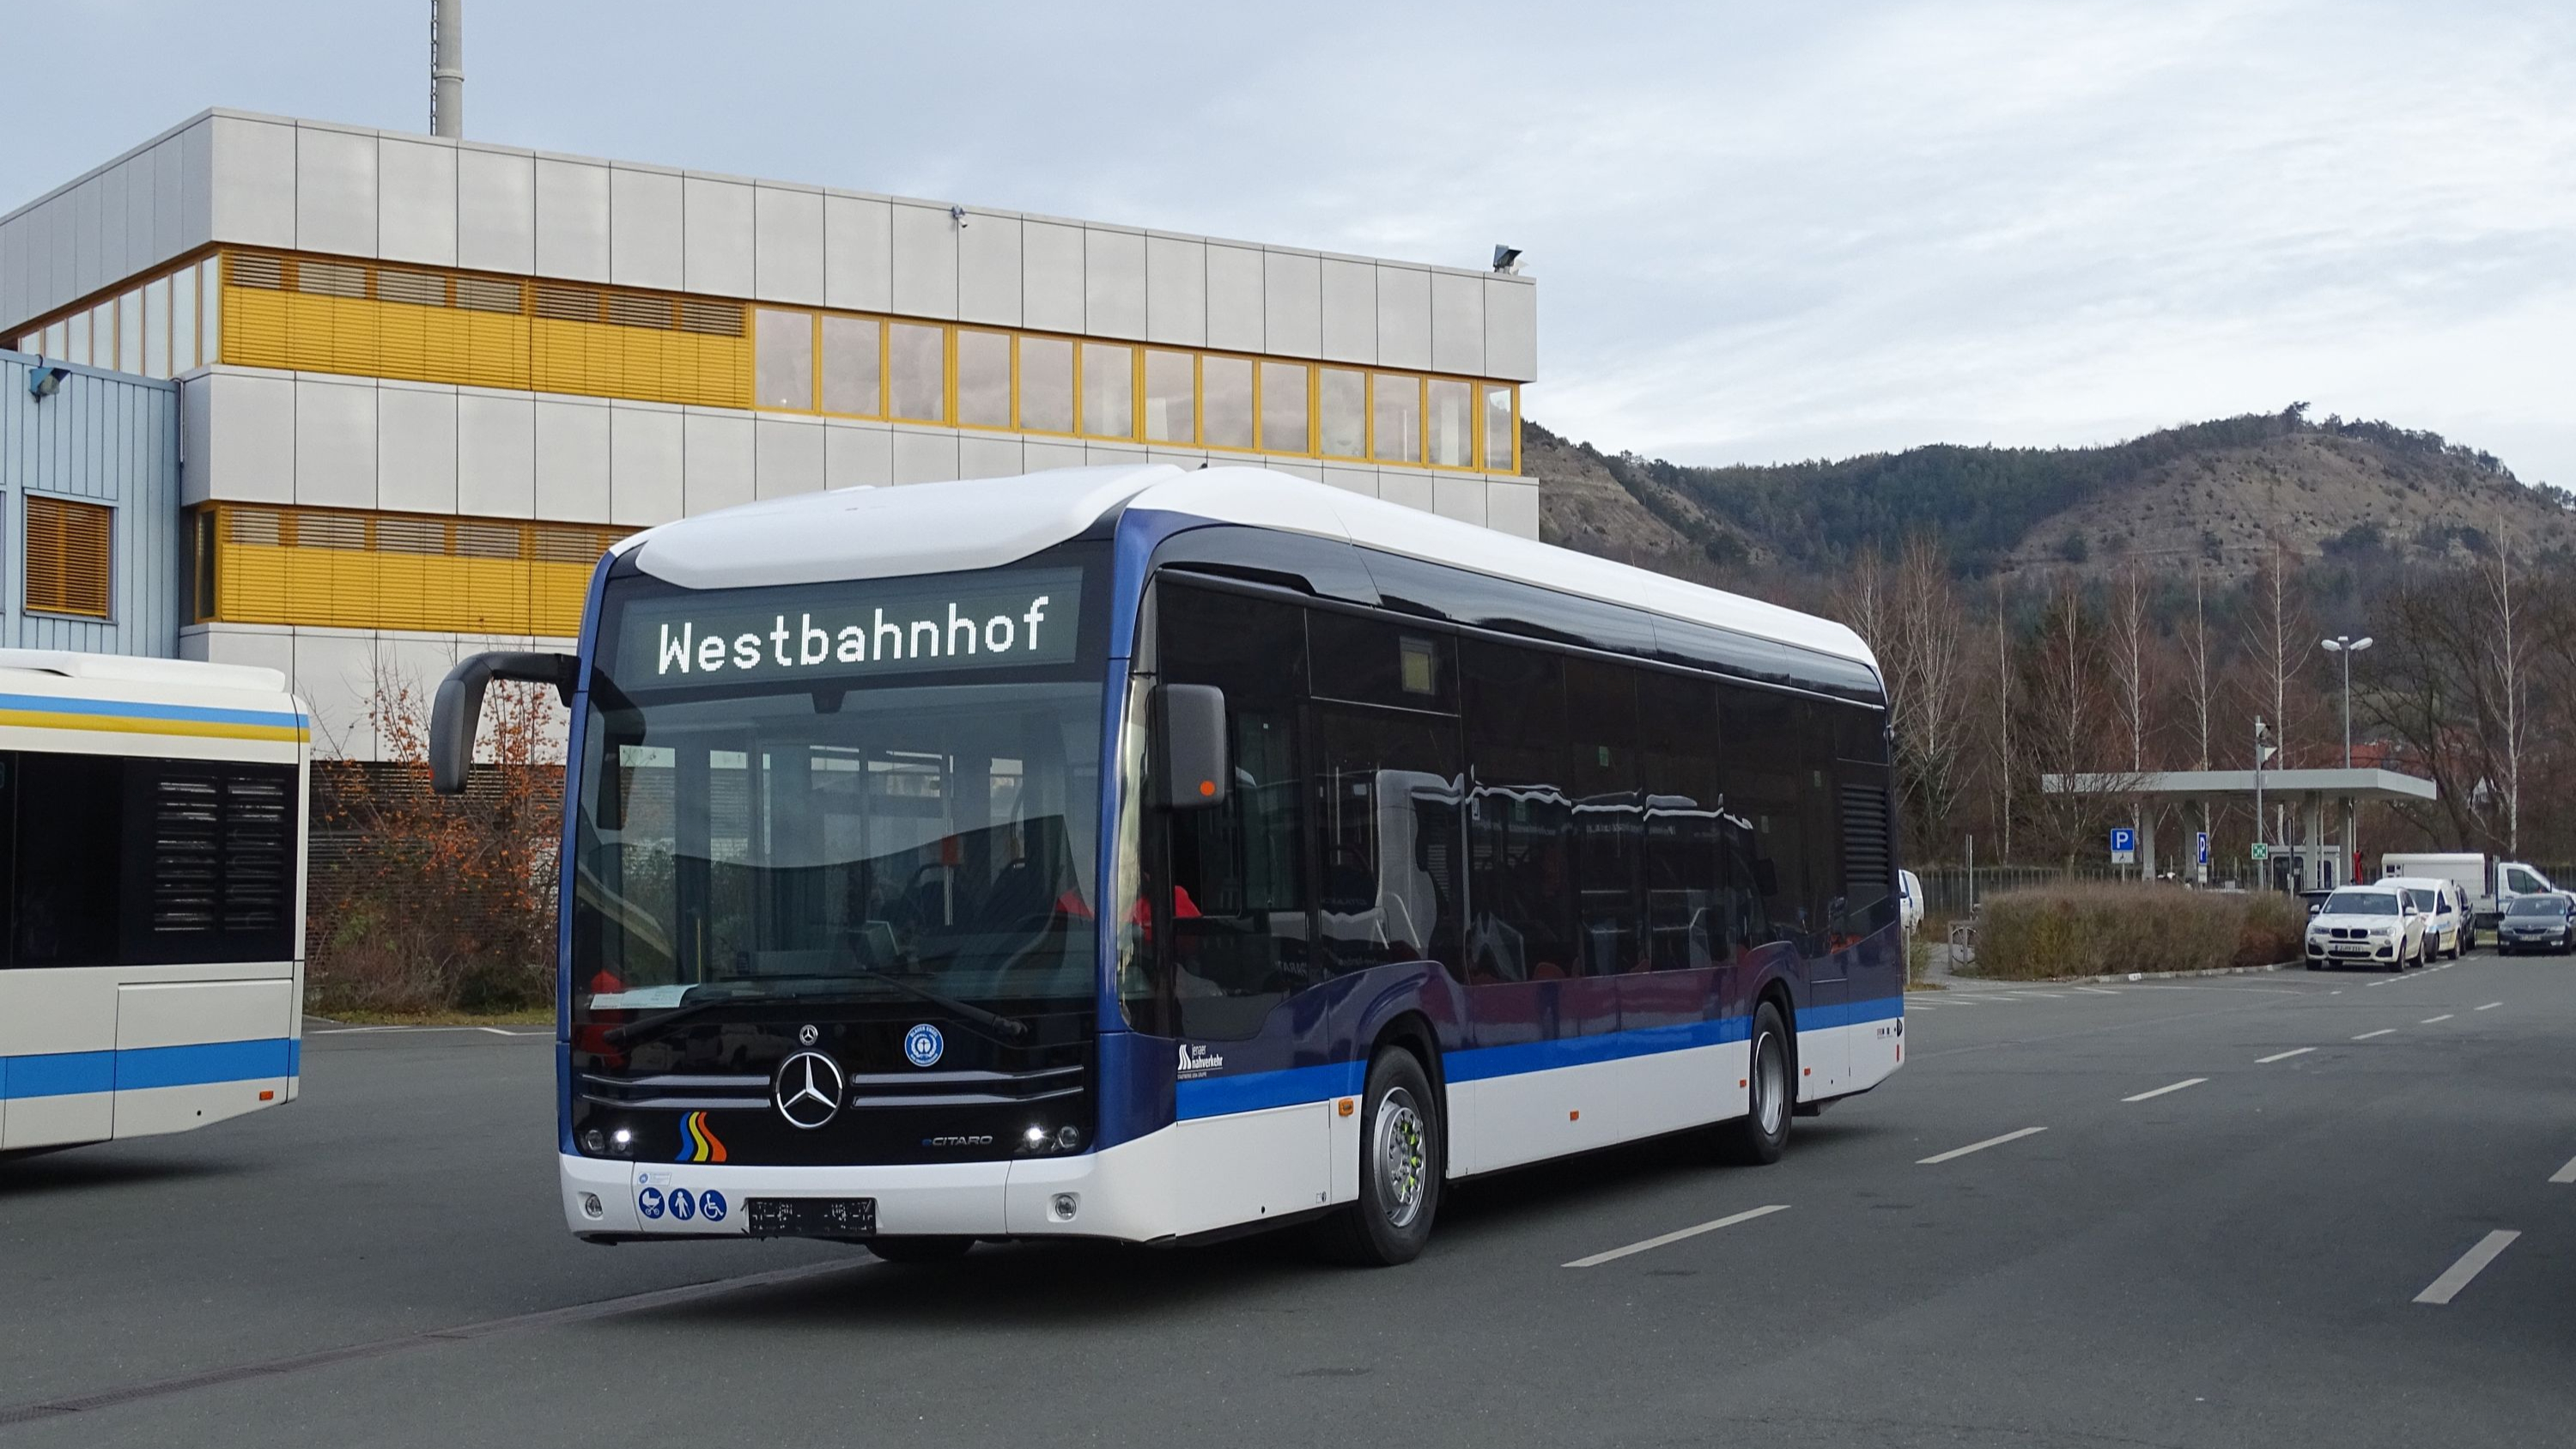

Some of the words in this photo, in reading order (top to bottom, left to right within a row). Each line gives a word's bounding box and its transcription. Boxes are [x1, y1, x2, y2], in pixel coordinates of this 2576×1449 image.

[659, 596, 1049, 674] Westbahnhof
[2116, 831, 2129, 849] P
[2199, 836, 2206, 861] P
[1192, 1053, 1224, 1069] nahverkehr
